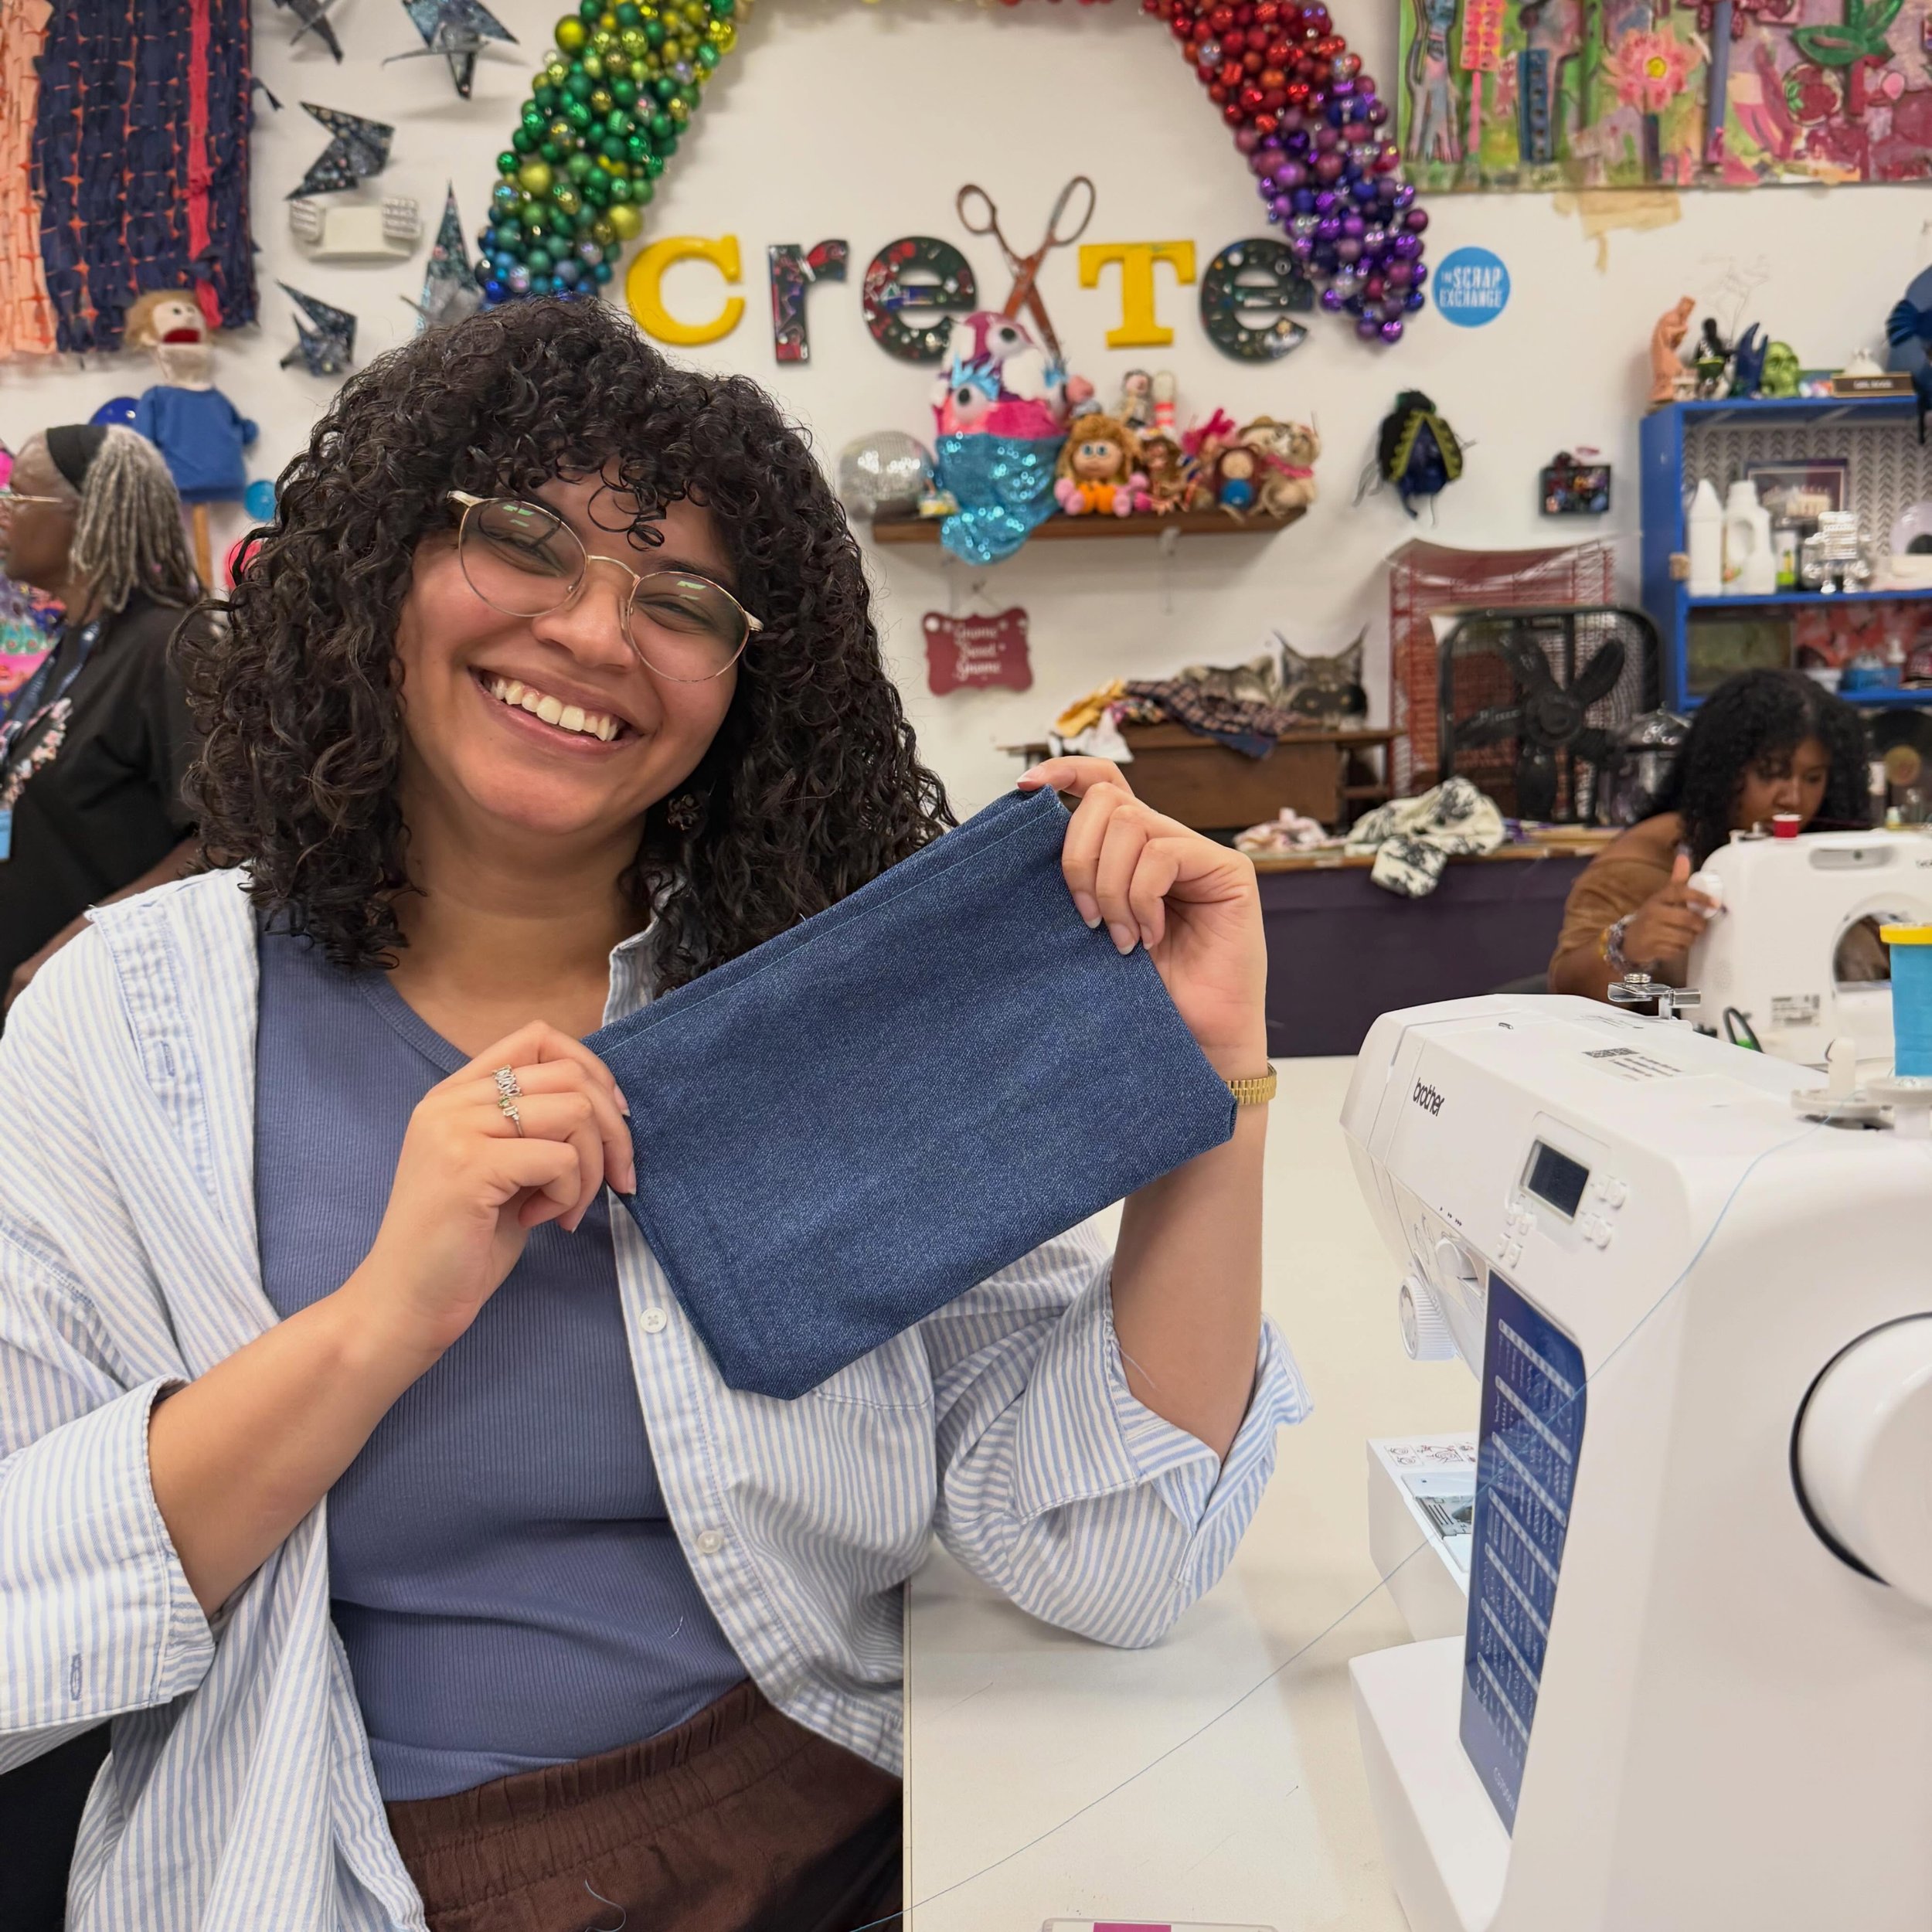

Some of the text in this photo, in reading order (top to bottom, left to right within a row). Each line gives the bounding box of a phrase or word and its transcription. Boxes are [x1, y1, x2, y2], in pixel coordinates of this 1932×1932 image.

[1453, 265, 1502, 288] SCRAP
[1439, 288, 1502, 308] EXCHANGE
[1413, 1077, 1444, 1117] brother
